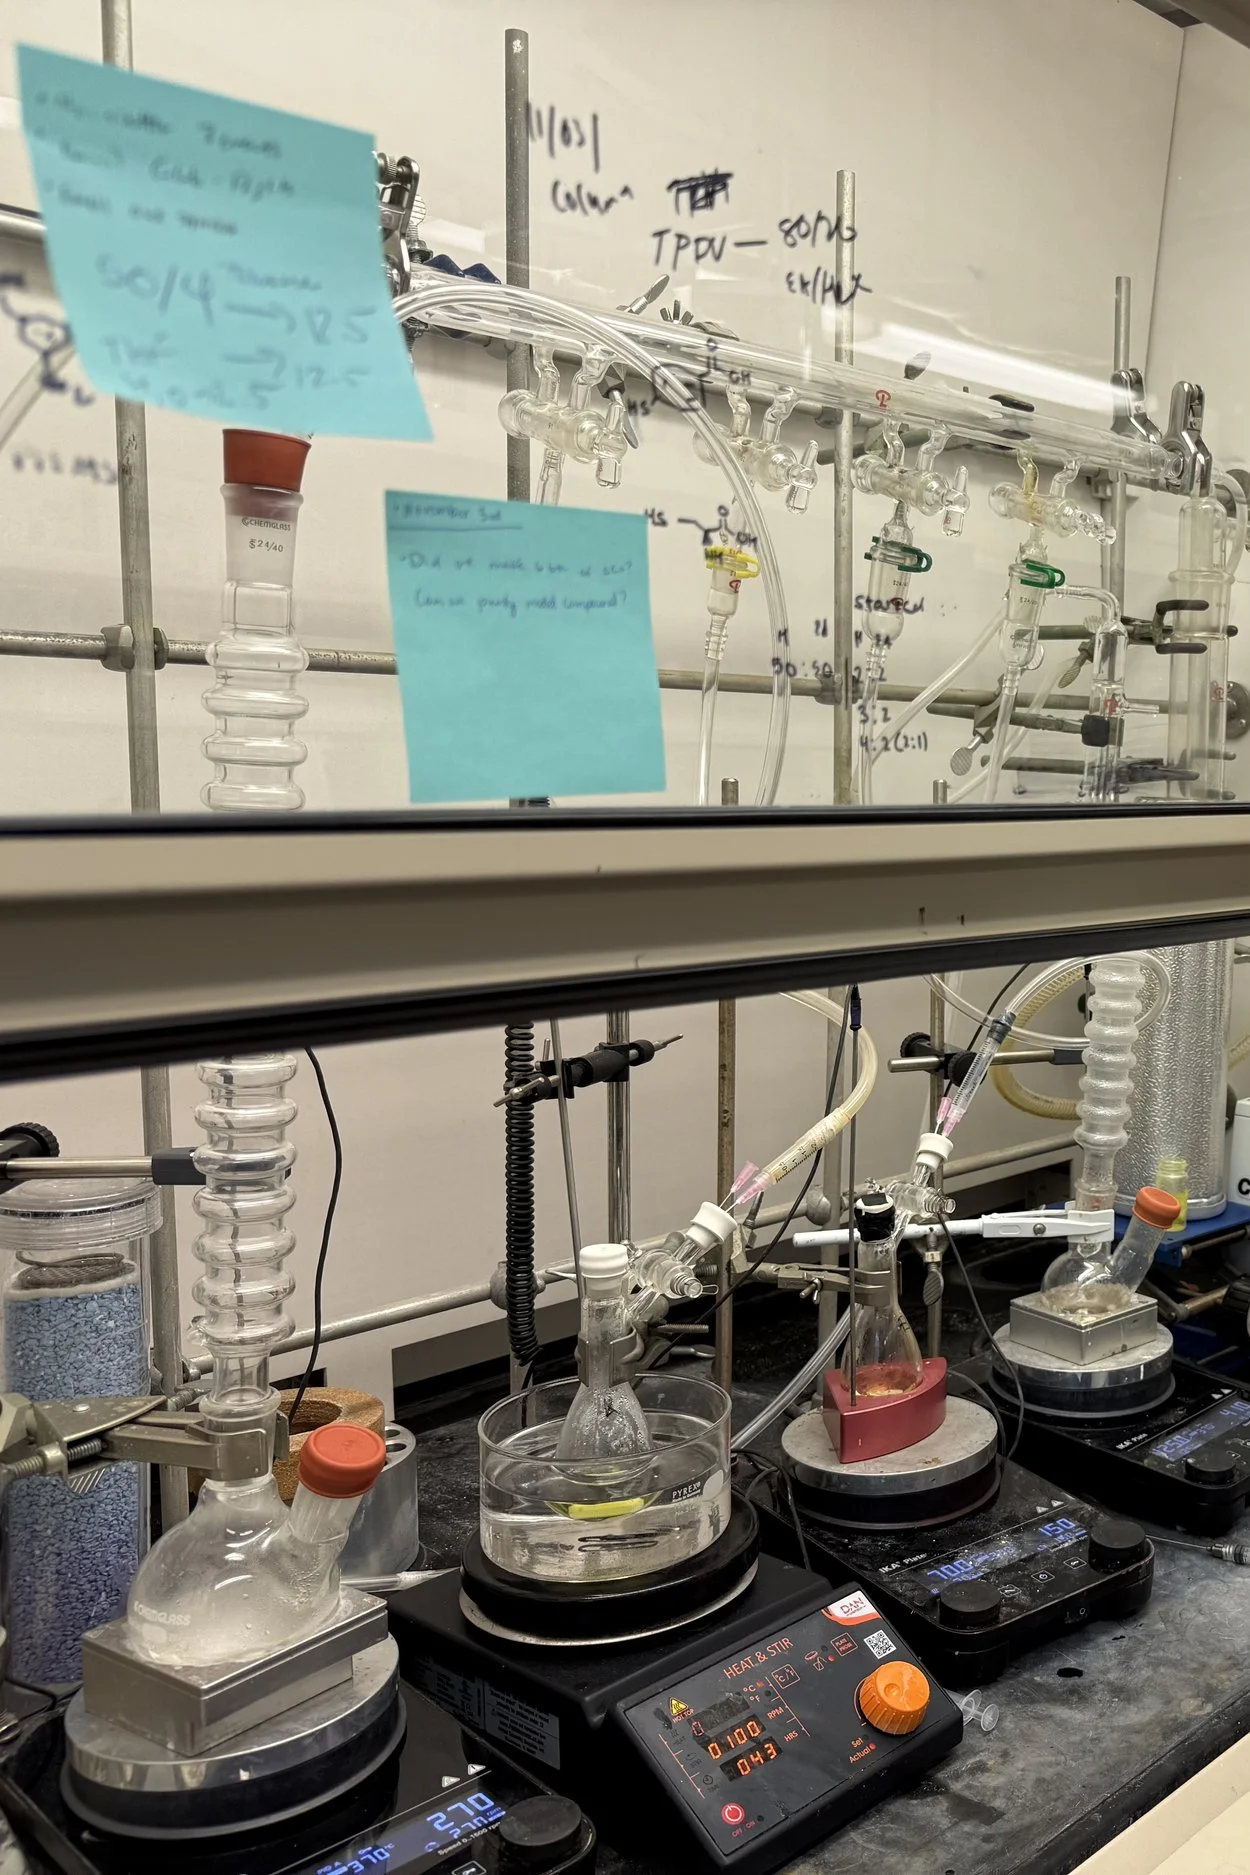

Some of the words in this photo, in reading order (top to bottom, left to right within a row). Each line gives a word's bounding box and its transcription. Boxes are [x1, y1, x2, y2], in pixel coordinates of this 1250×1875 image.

[1038, 1517, 1077, 1538] 150
[723, 1656, 753, 1680] HEAT
[754, 1650, 769, 1664] &
[766, 1637, 795, 1658] STIR
[766, 1706, 785, 1720] RPM
[783, 1730, 799, 1743] HRS
[848, 1745, 872, 1764] Actual
[426, 1792, 495, 1832] 270
